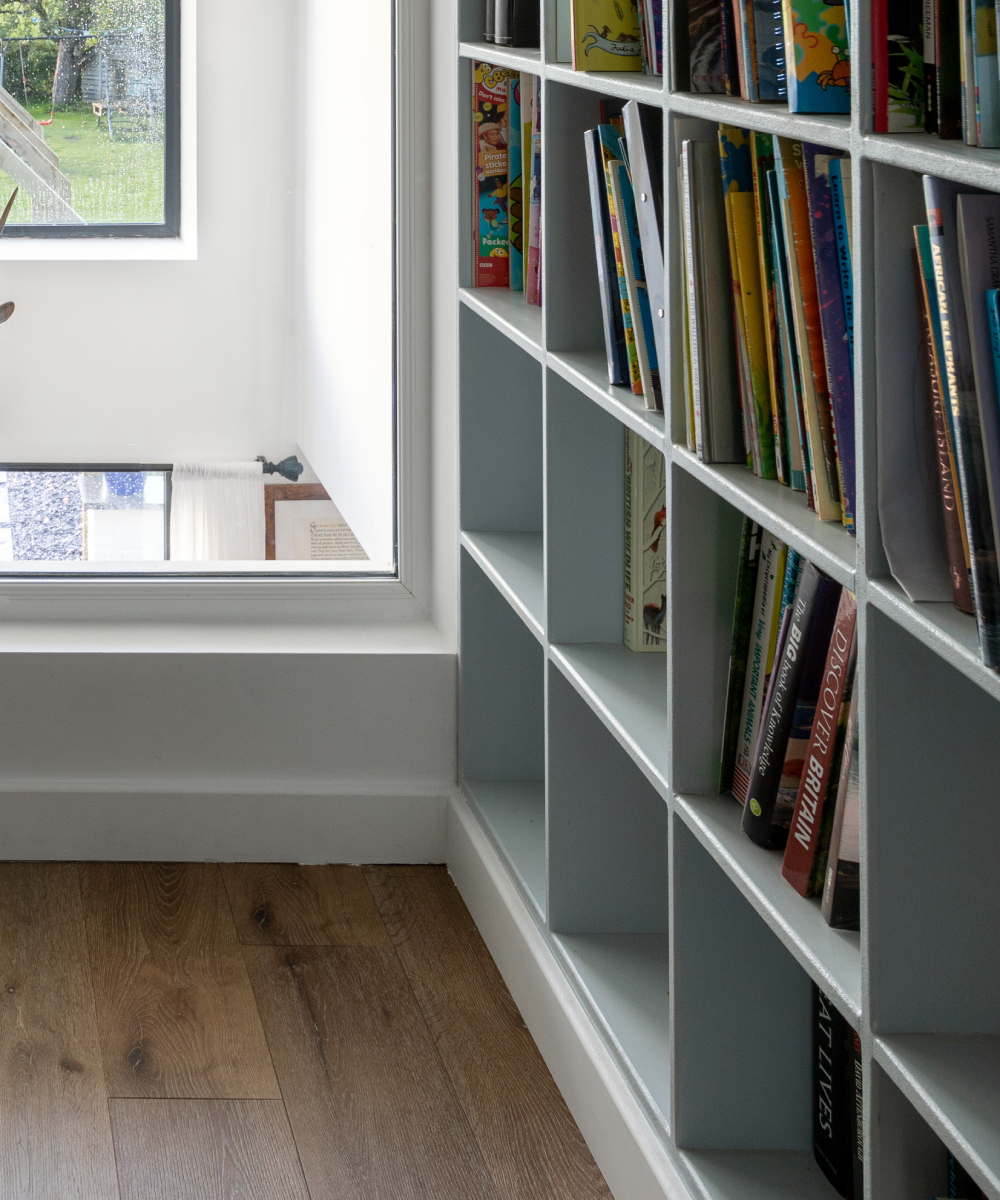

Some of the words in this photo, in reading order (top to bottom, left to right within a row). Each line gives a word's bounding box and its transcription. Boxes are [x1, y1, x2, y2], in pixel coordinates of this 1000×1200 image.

[610, 43, 635, 53] Julia
[493, 95, 506, 103] miss
[484, 152, 507, 161] Pirate
[484, 160, 507, 169] sticke
[831, 174, 843, 221] Learn
[837, 225, 845, 240] to
[985, 216, 998, 264] SAMANTHA
[839, 245, 849, 290] Write
[842, 293, 852, 321] the
[932, 243, 949, 314] AFRICAN
[941, 320, 961, 418] ELEPHANTS
[936, 429, 955, 512] ISLAND
[765, 547, 773, 559] My
[761, 559, 772, 608] Encyclopedia
[754, 619, 767, 641] Very
[794, 597, 807, 623] The
[786, 623, 802, 662] BIG
[749, 642, 763, 700] IMPORTANT
[777, 659, 794, 693] book
[812, 627, 848, 755] DISCOVER
[773, 692, 783, 705] of
[743, 698, 757, 744] ANIMALS
[758, 705, 780, 778] Knowledge
[793, 754, 824, 851] BRITAIN
[818, 1044, 833, 1138] LIVES
[854, 1058, 863, 1092] DAVID
[854, 1089, 864, 1162] ATTENBOROUGH
